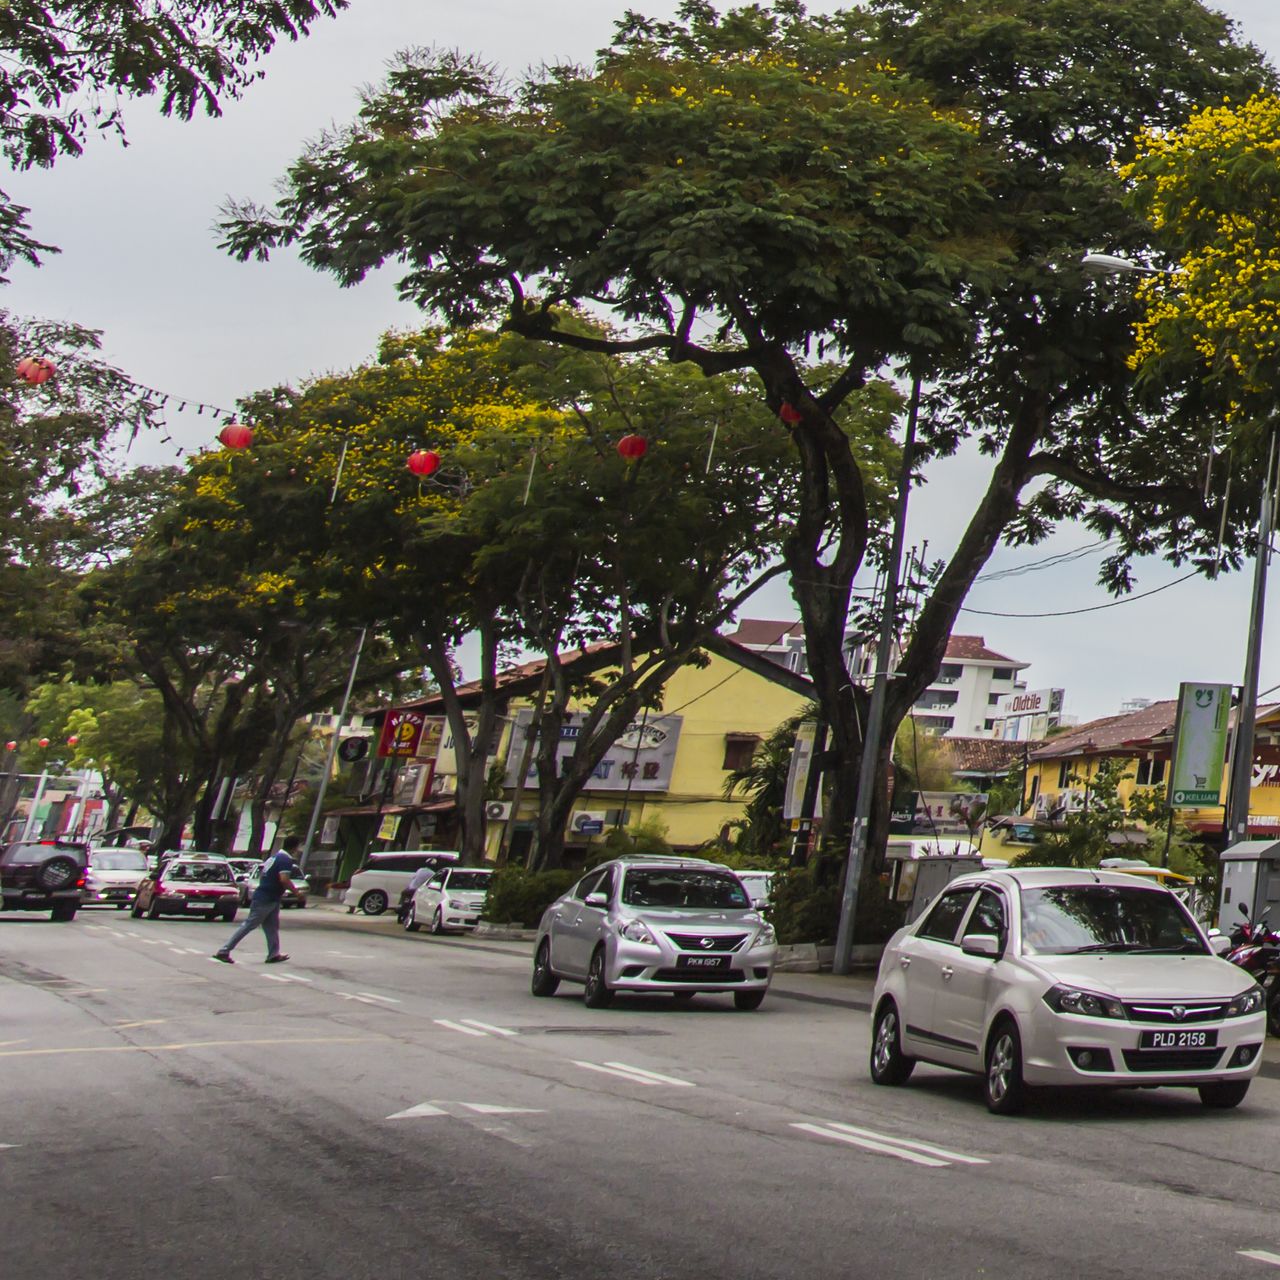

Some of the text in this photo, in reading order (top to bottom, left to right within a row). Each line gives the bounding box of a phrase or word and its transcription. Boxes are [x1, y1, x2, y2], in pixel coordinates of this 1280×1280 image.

[1013, 694, 1041, 712] Oldtile
[1186, 793, 1218, 801] KELUAR
[1153, 1032, 1207, 1047] PLD 2158
